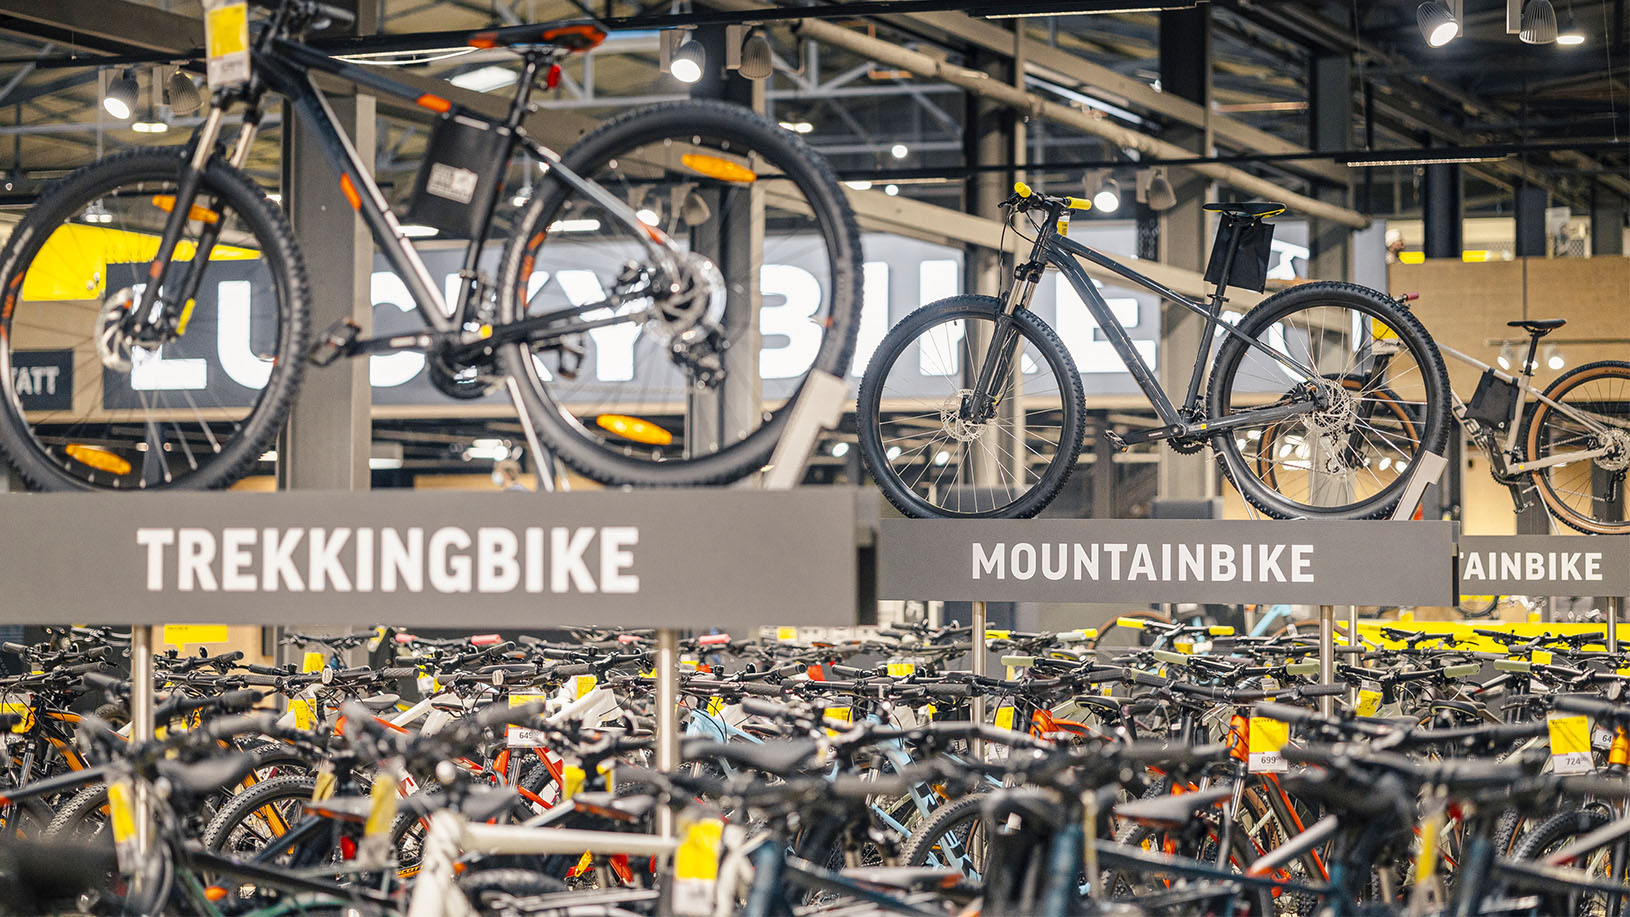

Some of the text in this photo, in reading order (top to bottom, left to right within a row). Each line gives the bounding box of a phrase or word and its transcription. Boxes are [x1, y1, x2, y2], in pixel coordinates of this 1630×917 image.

[137, 527, 640, 593] TREKKINGBIKE
[972, 542, 1314, 583] MOUNTAINBIKE
[1460, 552, 1603, 580] AINBIKE
